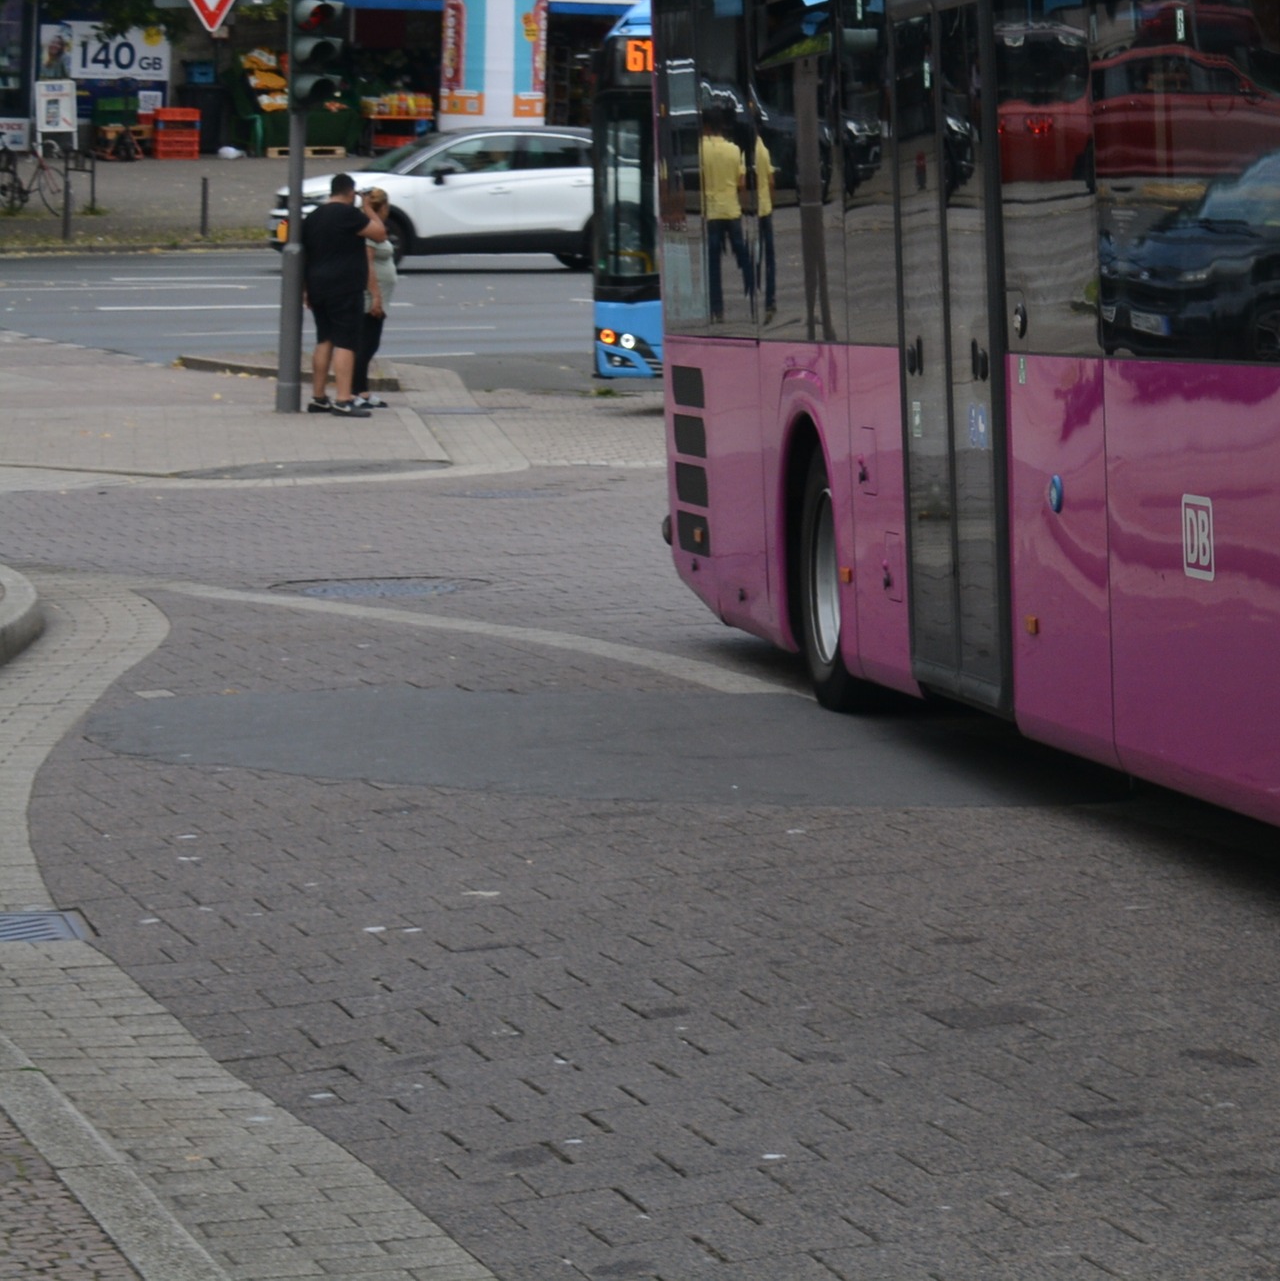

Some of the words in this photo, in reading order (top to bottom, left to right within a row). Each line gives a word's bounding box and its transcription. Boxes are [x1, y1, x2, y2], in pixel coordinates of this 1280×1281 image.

[81, 41, 135, 70] 140
[139, 57, 163, 70] GB
[1185, 504, 1211, 570] DB
